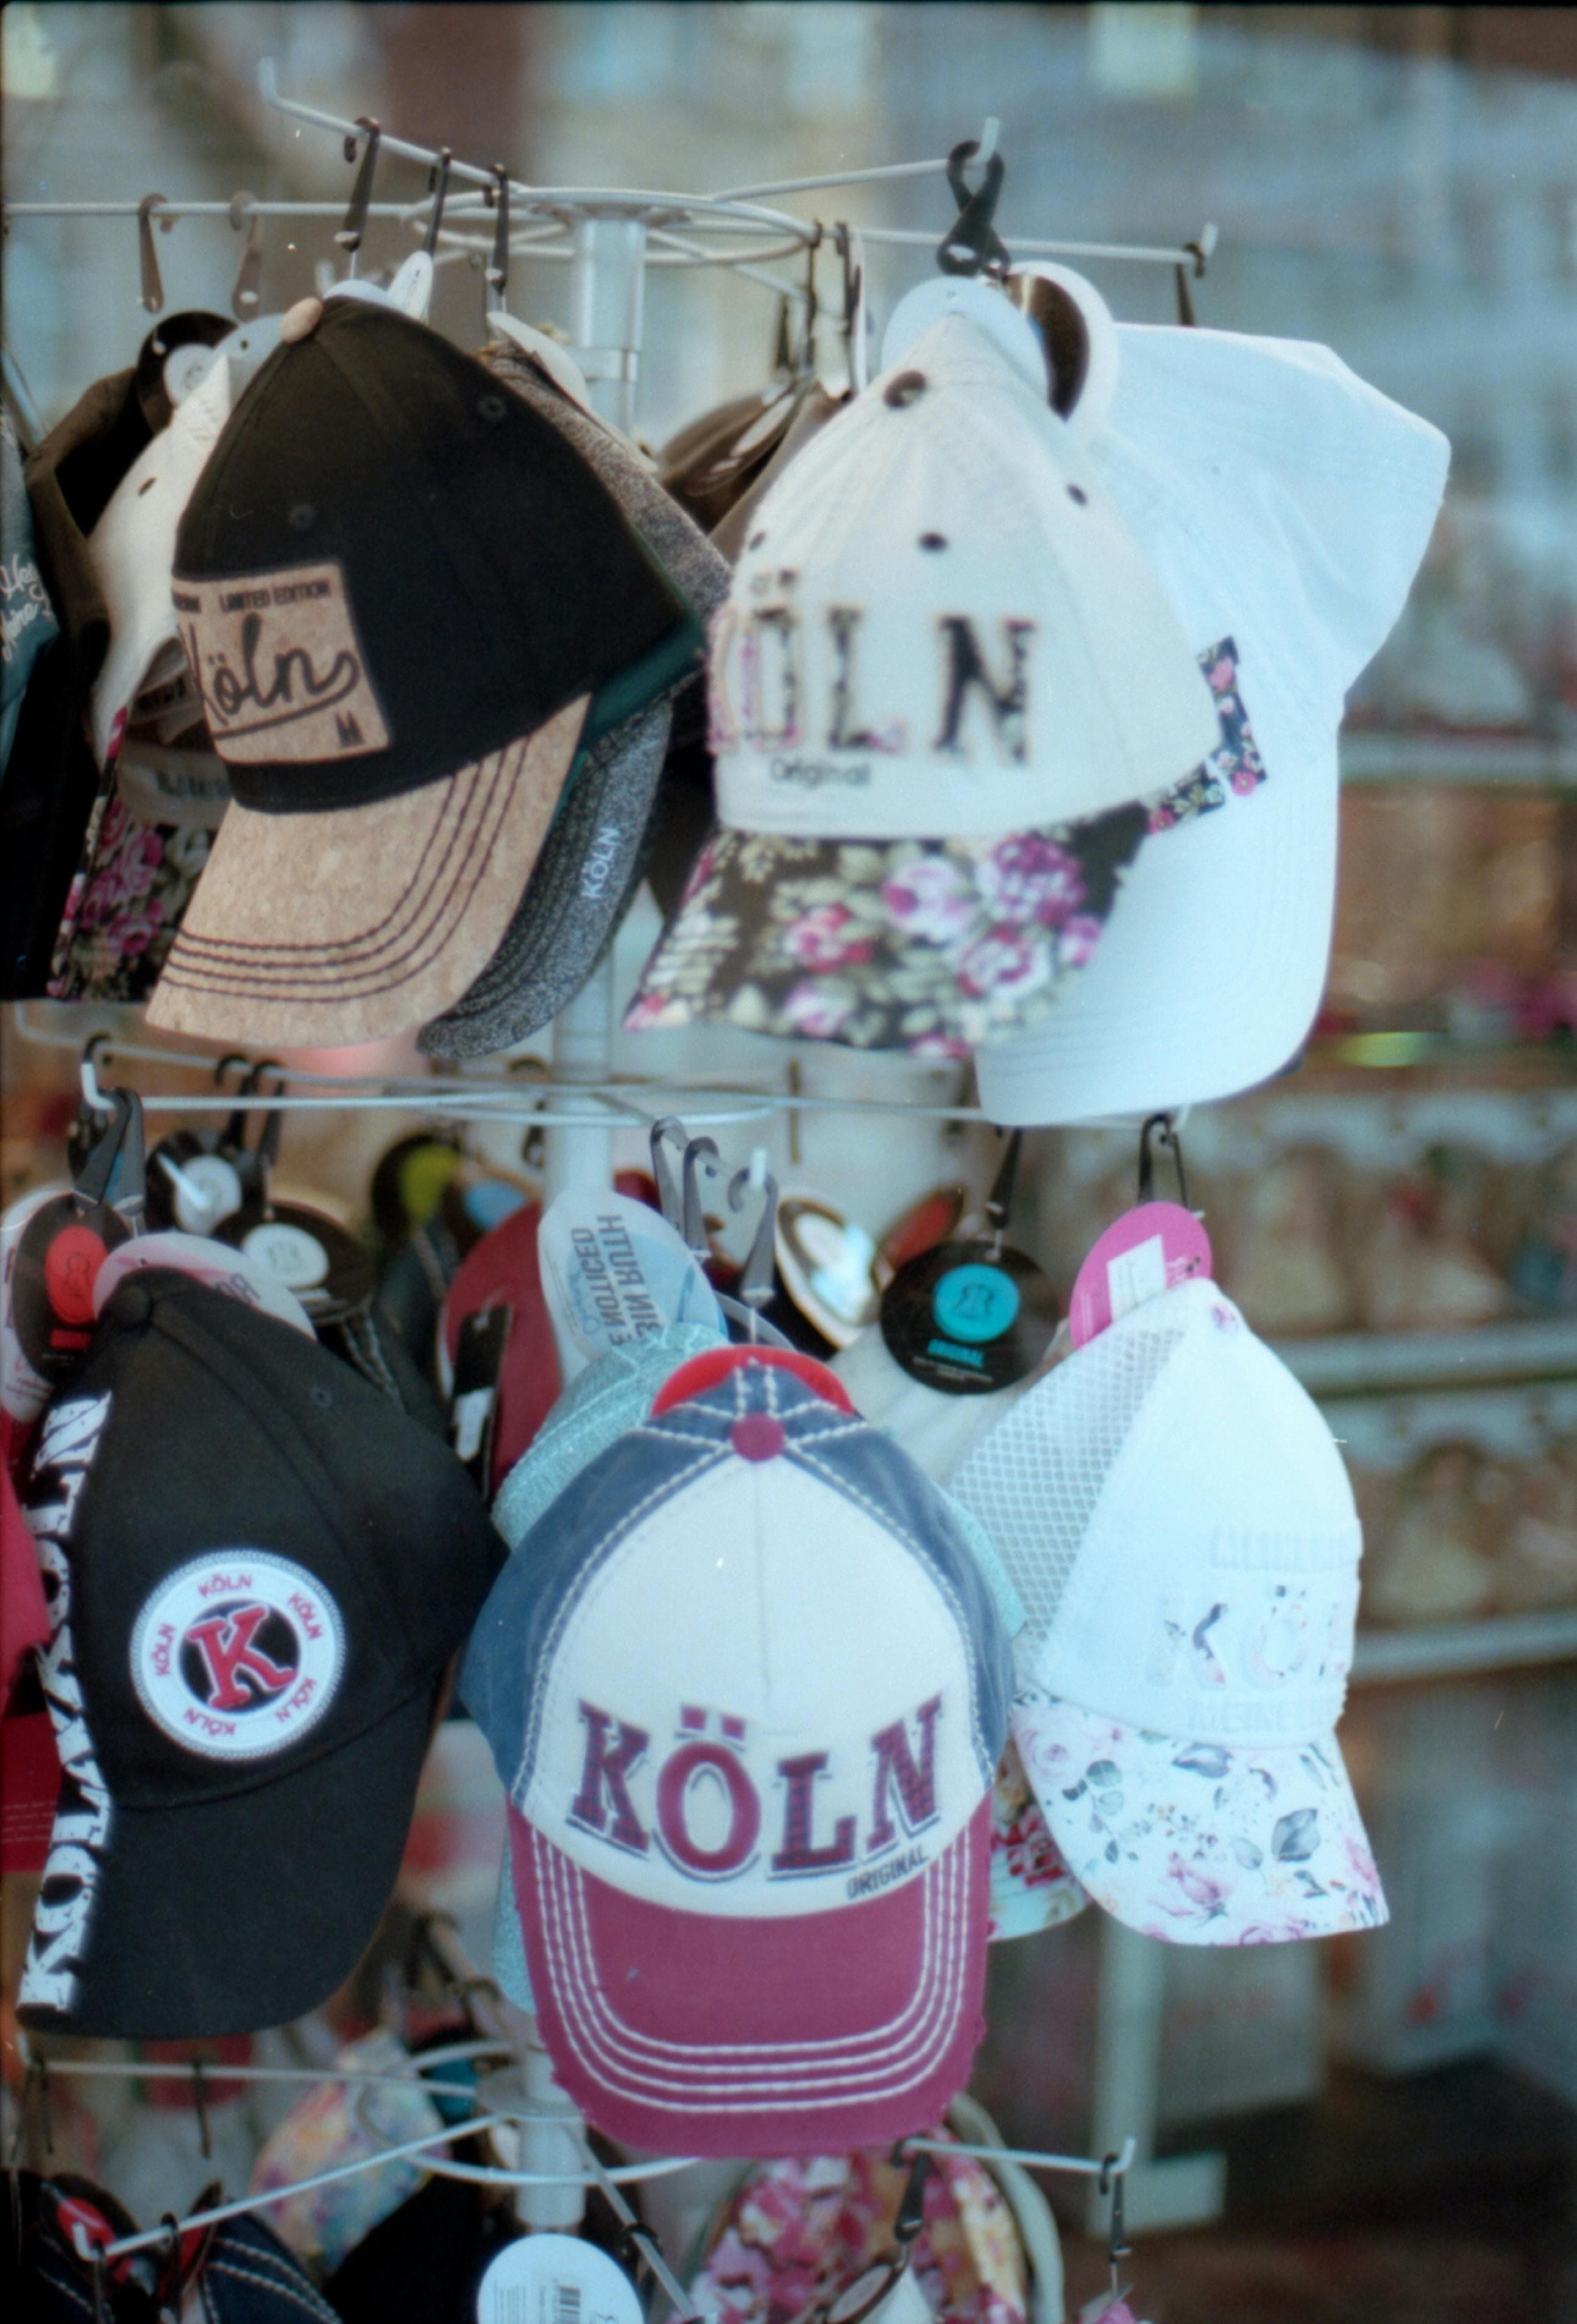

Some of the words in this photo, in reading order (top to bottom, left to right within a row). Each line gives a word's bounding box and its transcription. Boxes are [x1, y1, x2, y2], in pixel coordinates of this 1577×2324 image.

[198, 1574, 252, 1598] KÖLN
[288, 1591, 323, 1640] KÖLN
[151, 1622, 176, 1677] KÖLN
[186, 1605, 299, 1711] K
[183, 1707, 237, 1737] KÖLN
[564, 1691, 944, 1883] KÖLN
[846, 1844, 929, 1899] ORIGINAL
